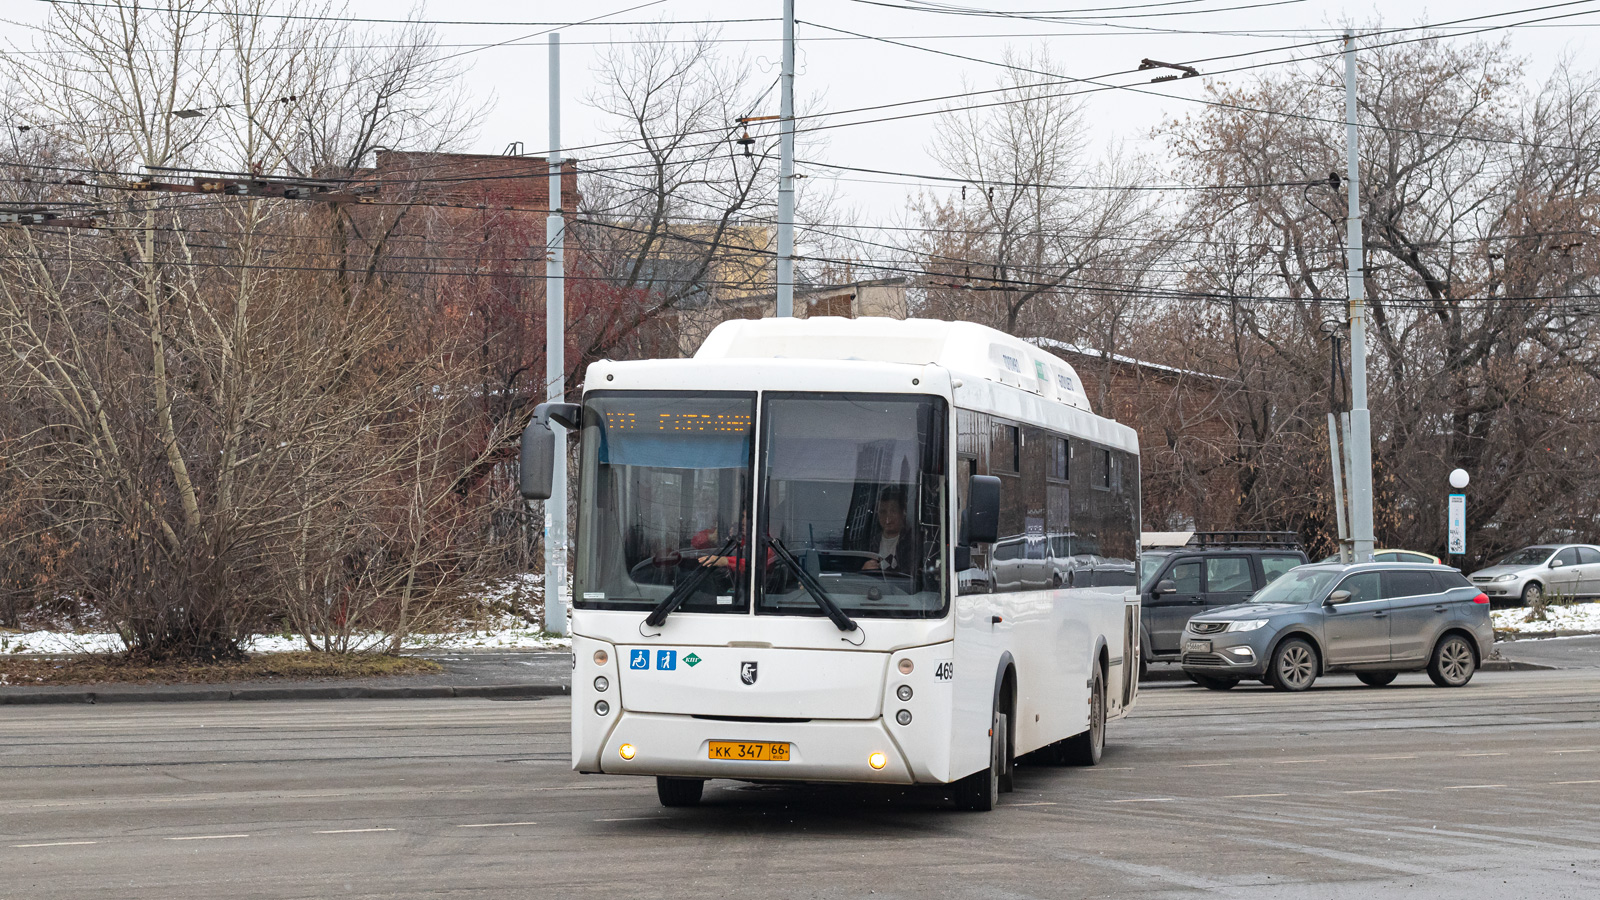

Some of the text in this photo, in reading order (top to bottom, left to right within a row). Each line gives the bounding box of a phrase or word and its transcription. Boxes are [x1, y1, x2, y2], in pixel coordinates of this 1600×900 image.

[935, 662, 953, 680] 469
[716, 745, 784, 758] КК 347 66
